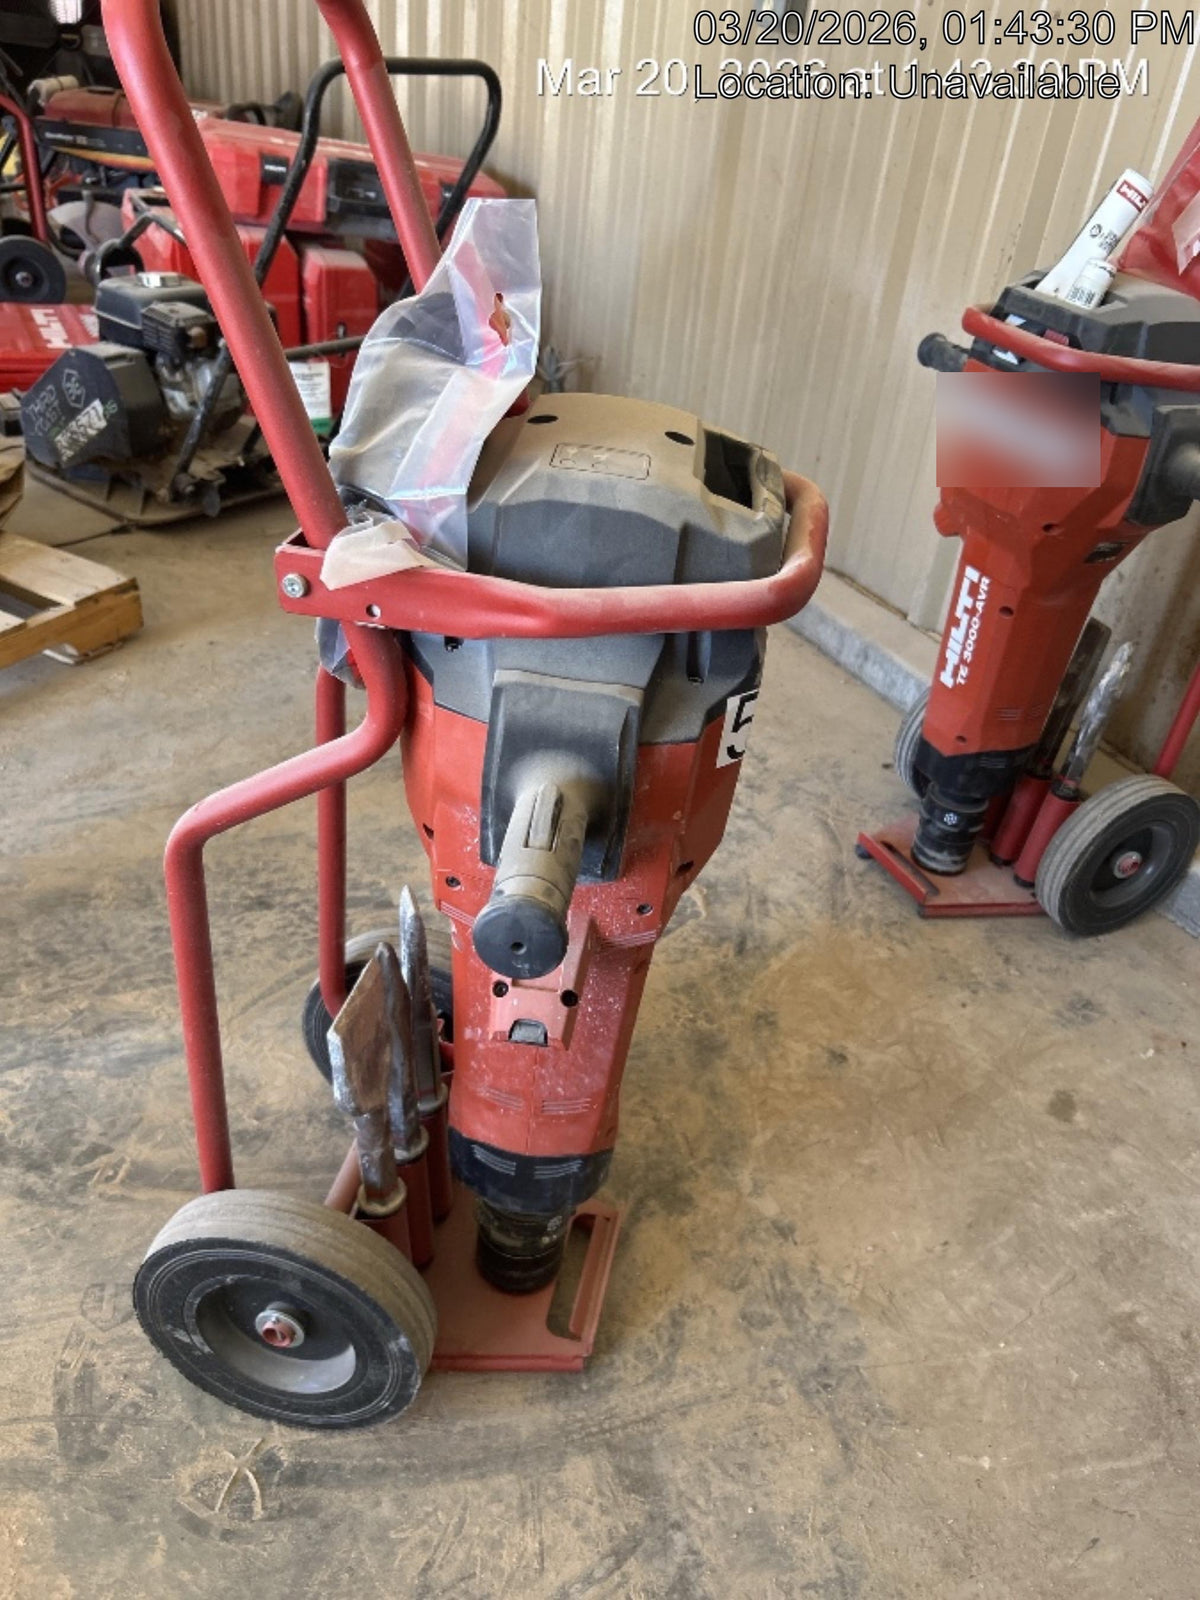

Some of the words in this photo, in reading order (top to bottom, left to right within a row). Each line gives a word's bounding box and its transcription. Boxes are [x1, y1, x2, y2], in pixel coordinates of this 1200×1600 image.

[939, 564, 982, 689] HILTI
[956, 663, 969, 686] TE
[963, 575, 992, 664] 3000-AVR
